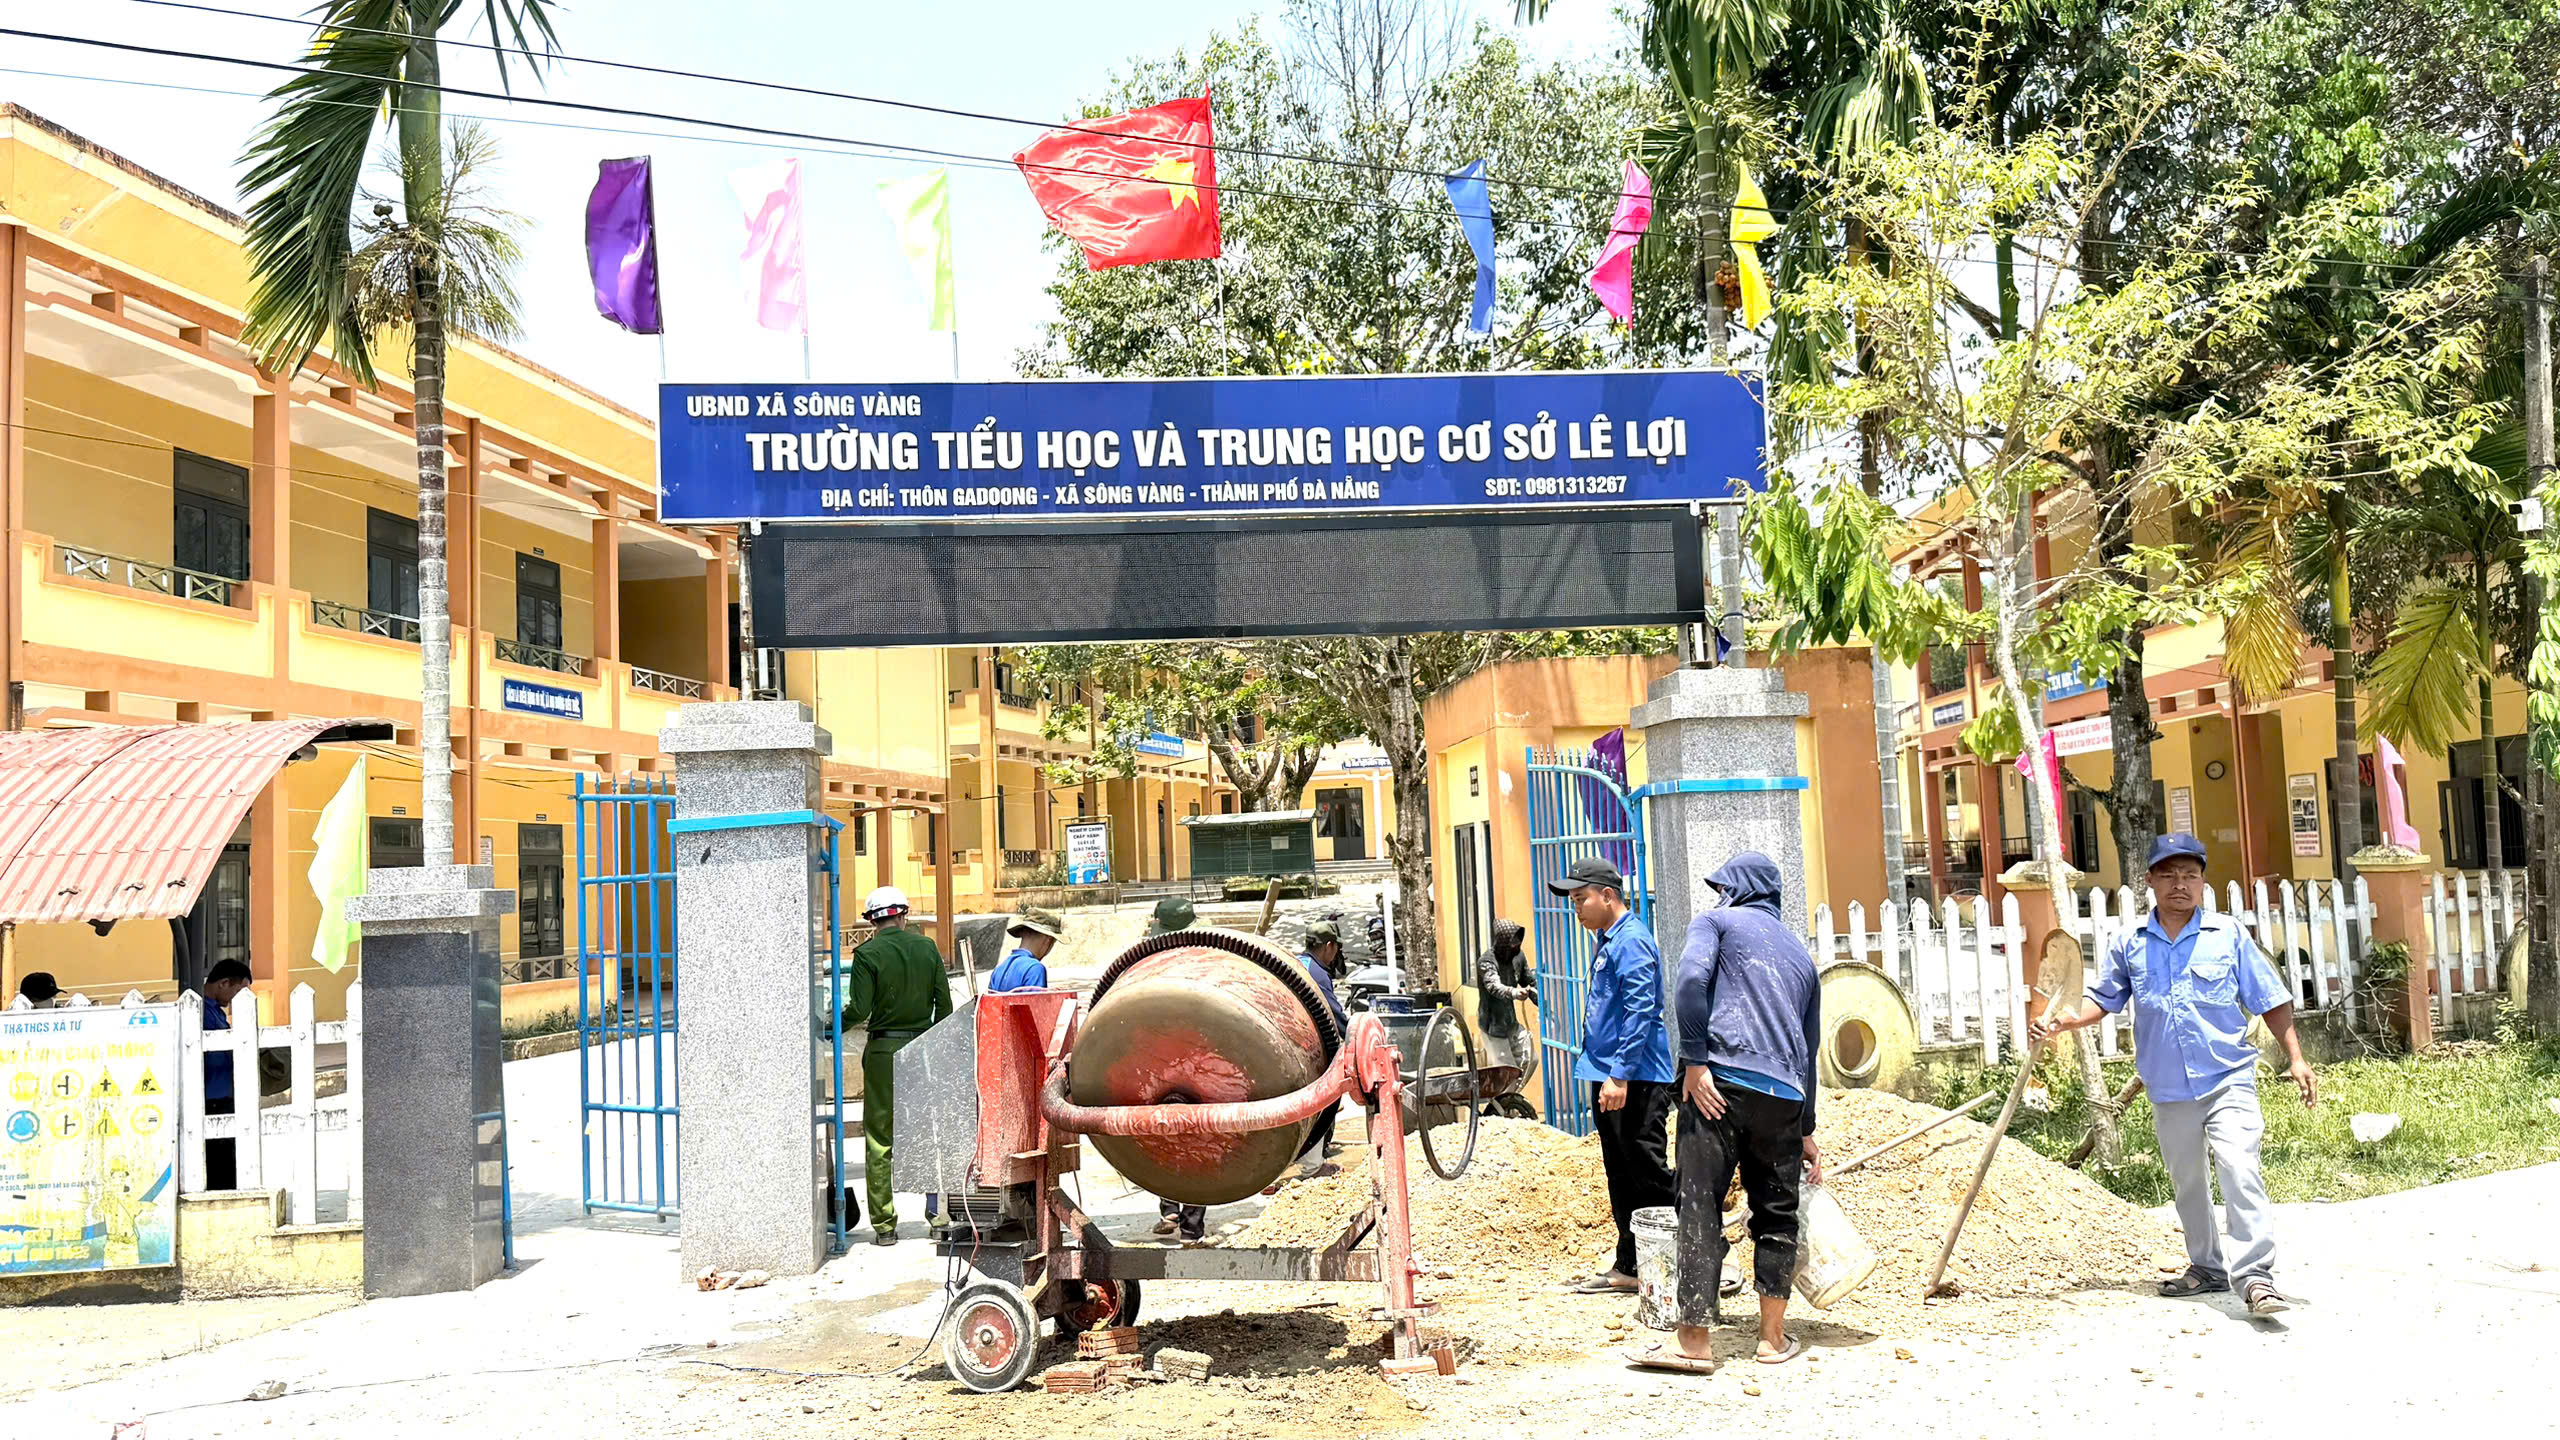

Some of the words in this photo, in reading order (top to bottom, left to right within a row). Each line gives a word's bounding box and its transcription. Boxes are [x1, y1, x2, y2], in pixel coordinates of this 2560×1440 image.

[686, 395, 750, 417] UBND
[755, 391, 788, 417] XÃ
[793, 391, 855, 417] SÔNG
[861, 391, 921, 416] VÀNG
[746, 423, 919, 471] TRƯỜNG
[931, 415, 1023, 470] TIỂU
[1037, 429, 1120, 477] HỌC
[1132, 421, 1187, 467] VÀ
[1197, 426, 1332, 466] TRUNG
[1344, 425, 1425, 472] HỌC
[1438, 420, 1492, 462] CƠ
[1503, 410, 1557, 461] SỞ
[1568, 413, 1614, 459] LÊ
[1625, 416, 1687, 465] LỢI
[821, 488, 854, 512] ĐỊA
[858, 482, 895, 507] CHỈ:
[898, 484, 948, 507] THÔN
[952, 486, 1038, 506] GADOONG
[1054, 483, 1080, 505] XÃ
[1083, 482, 1133, 505] SÔNG
[1137, 481, 1185, 504] VÀNG
[1200, 480, 1259, 503] THÀNH
[1263, 476, 1299, 501] PHỐ
[1302, 478, 1328, 501] ĐÀ
[1330, 475, 1380, 500] NẴNG
[1485, 476, 1522, 497] SĐT:
[1525, 475, 1627, 496] 0981313267
[4, 1022, 50, 1034] TH&THCS
